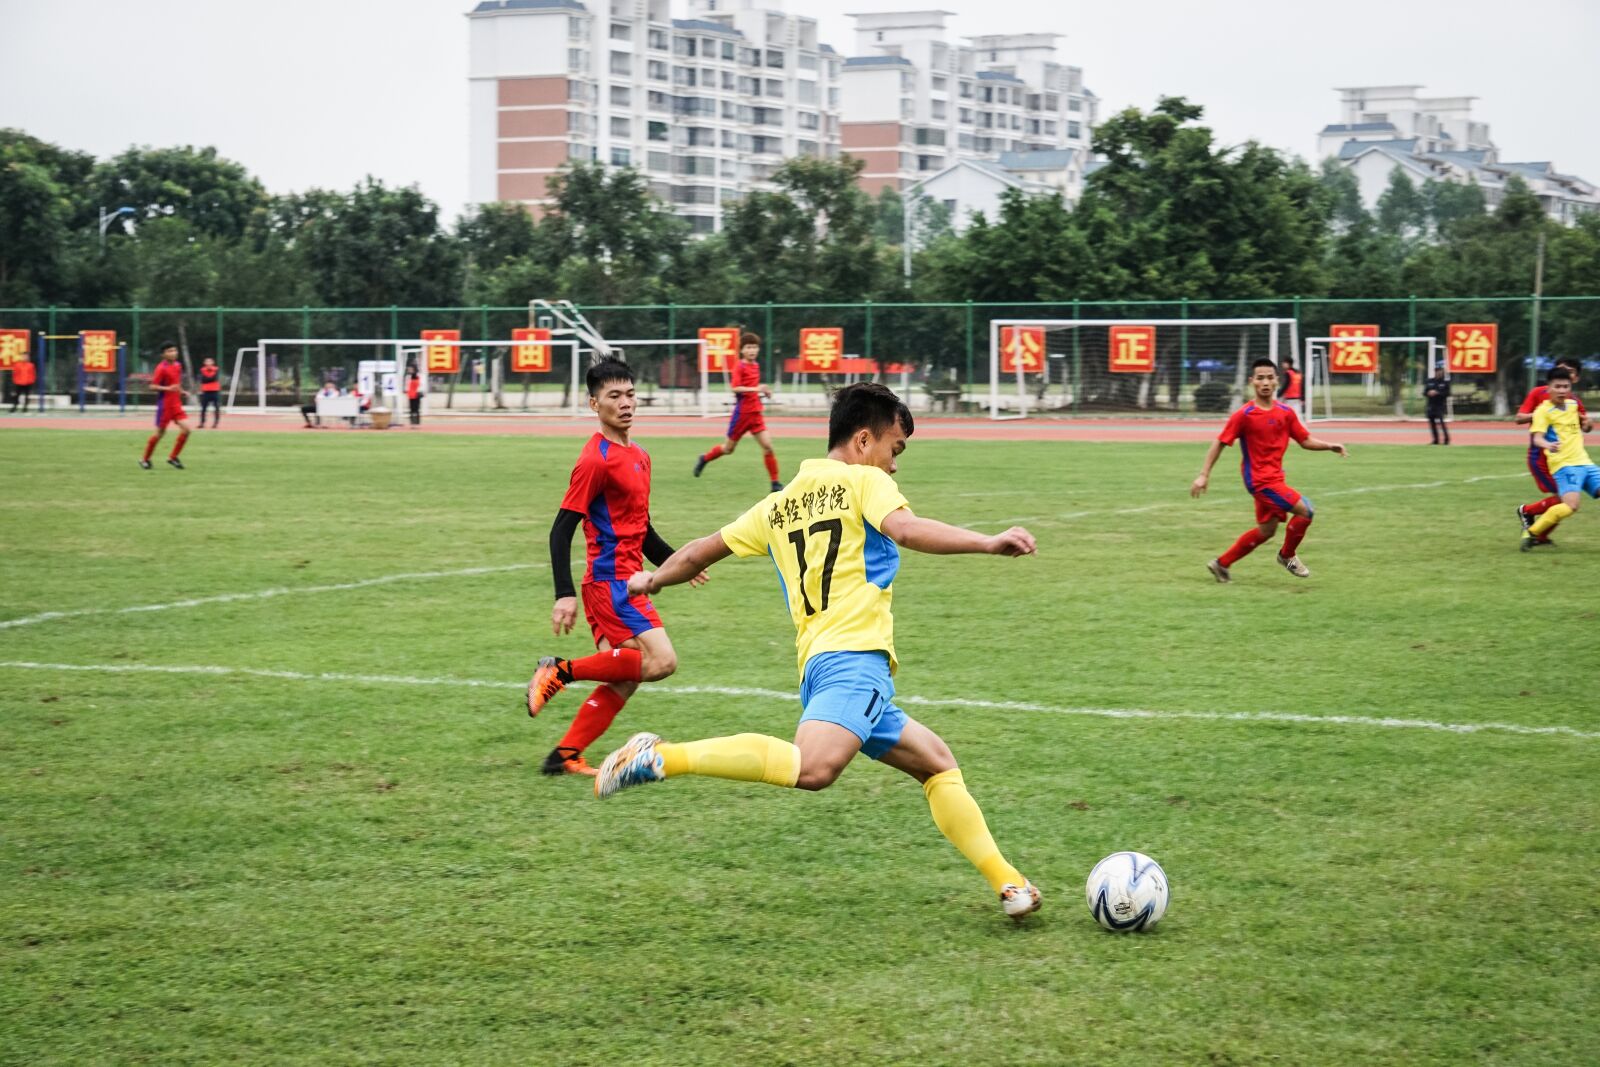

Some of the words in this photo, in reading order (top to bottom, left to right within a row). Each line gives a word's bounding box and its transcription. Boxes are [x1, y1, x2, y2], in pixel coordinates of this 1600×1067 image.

[0, 334, 27, 365] 和
[428, 334, 452, 368] 自
[518, 334, 544, 367] 由
[705, 333, 735, 367] 平
[805, 333, 838, 368] 等
[1005, 332, 1040, 366] 公
[1113, 333, 1150, 365] 正
[1335, 330, 1373, 367] 法
[1452, 330, 1491, 368] 治
[788, 518, 843, 616] 17
